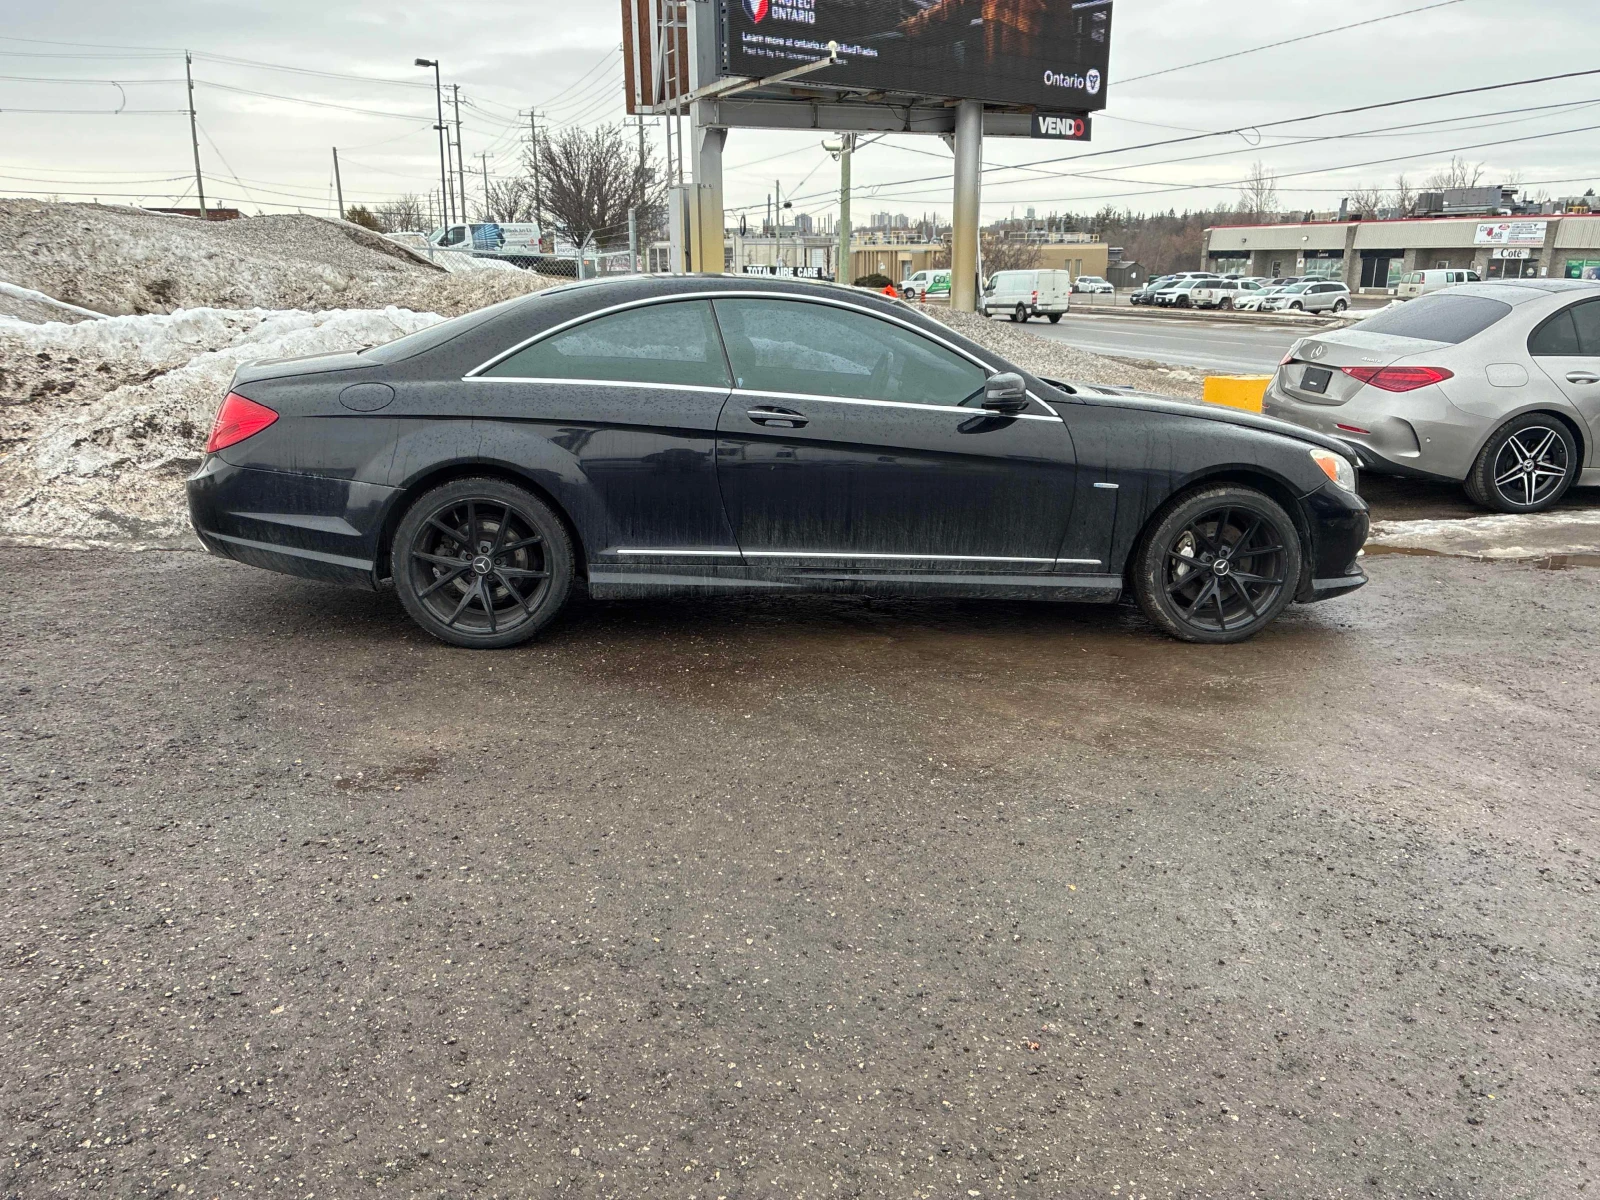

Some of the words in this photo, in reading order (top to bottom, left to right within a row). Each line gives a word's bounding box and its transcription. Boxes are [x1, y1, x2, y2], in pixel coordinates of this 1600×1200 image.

[772, 6, 816, 24] ONTARIO
[742, 31, 764, 43] Learn
[765, 35, 784, 46] more
[785, 38, 793, 47] at
[1043, 70, 1084, 89] Ontario
[1038, 116, 1085, 137] VENDO
[746, 266, 773, 276] TOTAL
[775, 266, 794, 277] AIRE
[797, 267, 819, 278] CARE
